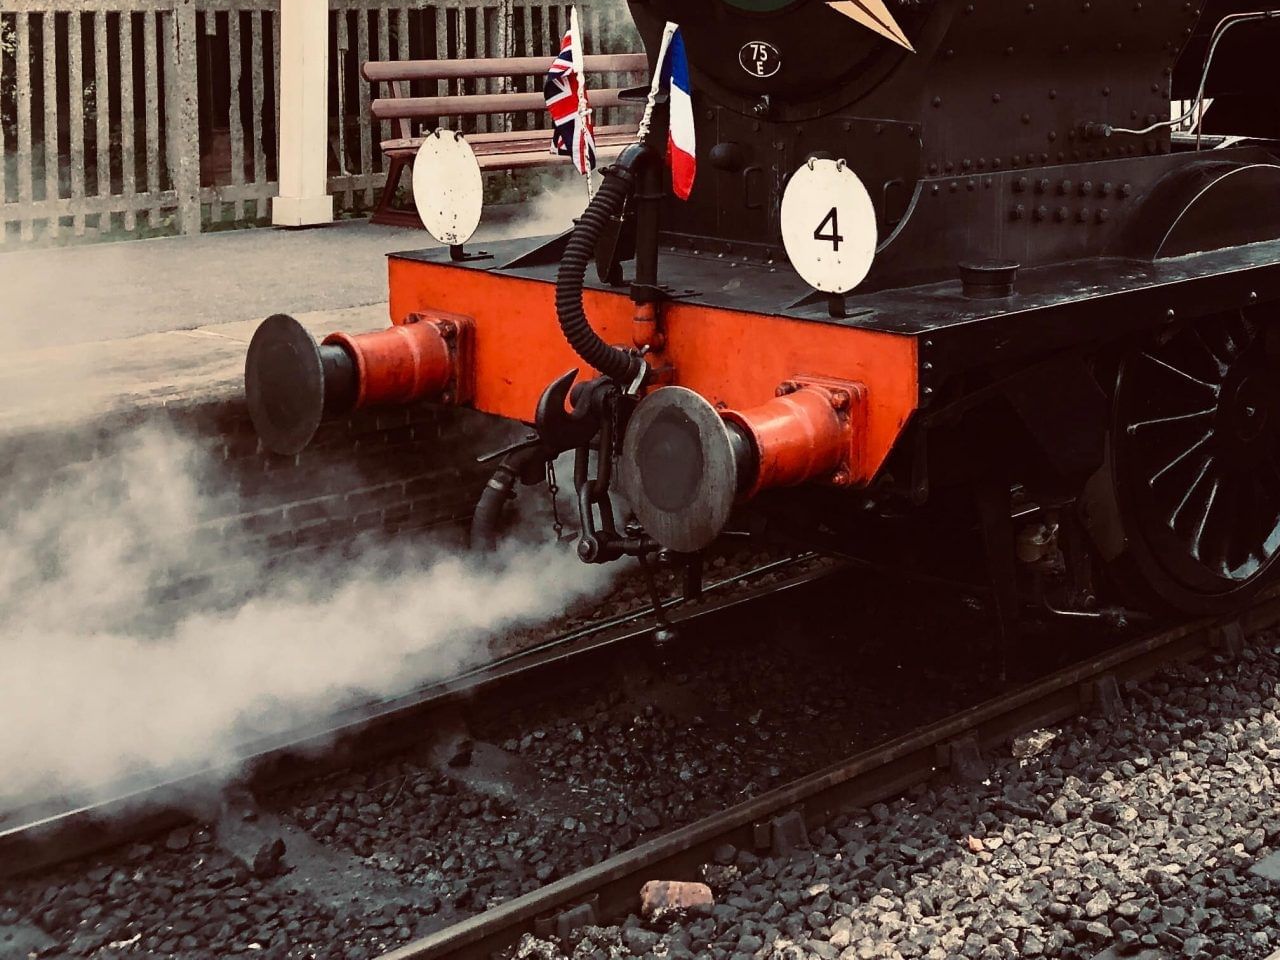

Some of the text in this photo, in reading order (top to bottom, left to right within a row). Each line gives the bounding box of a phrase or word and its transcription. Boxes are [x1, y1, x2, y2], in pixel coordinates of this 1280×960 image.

[750, 44, 768, 61] 75
[756, 61, 764, 75] E
[813, 206, 844, 252] 4
